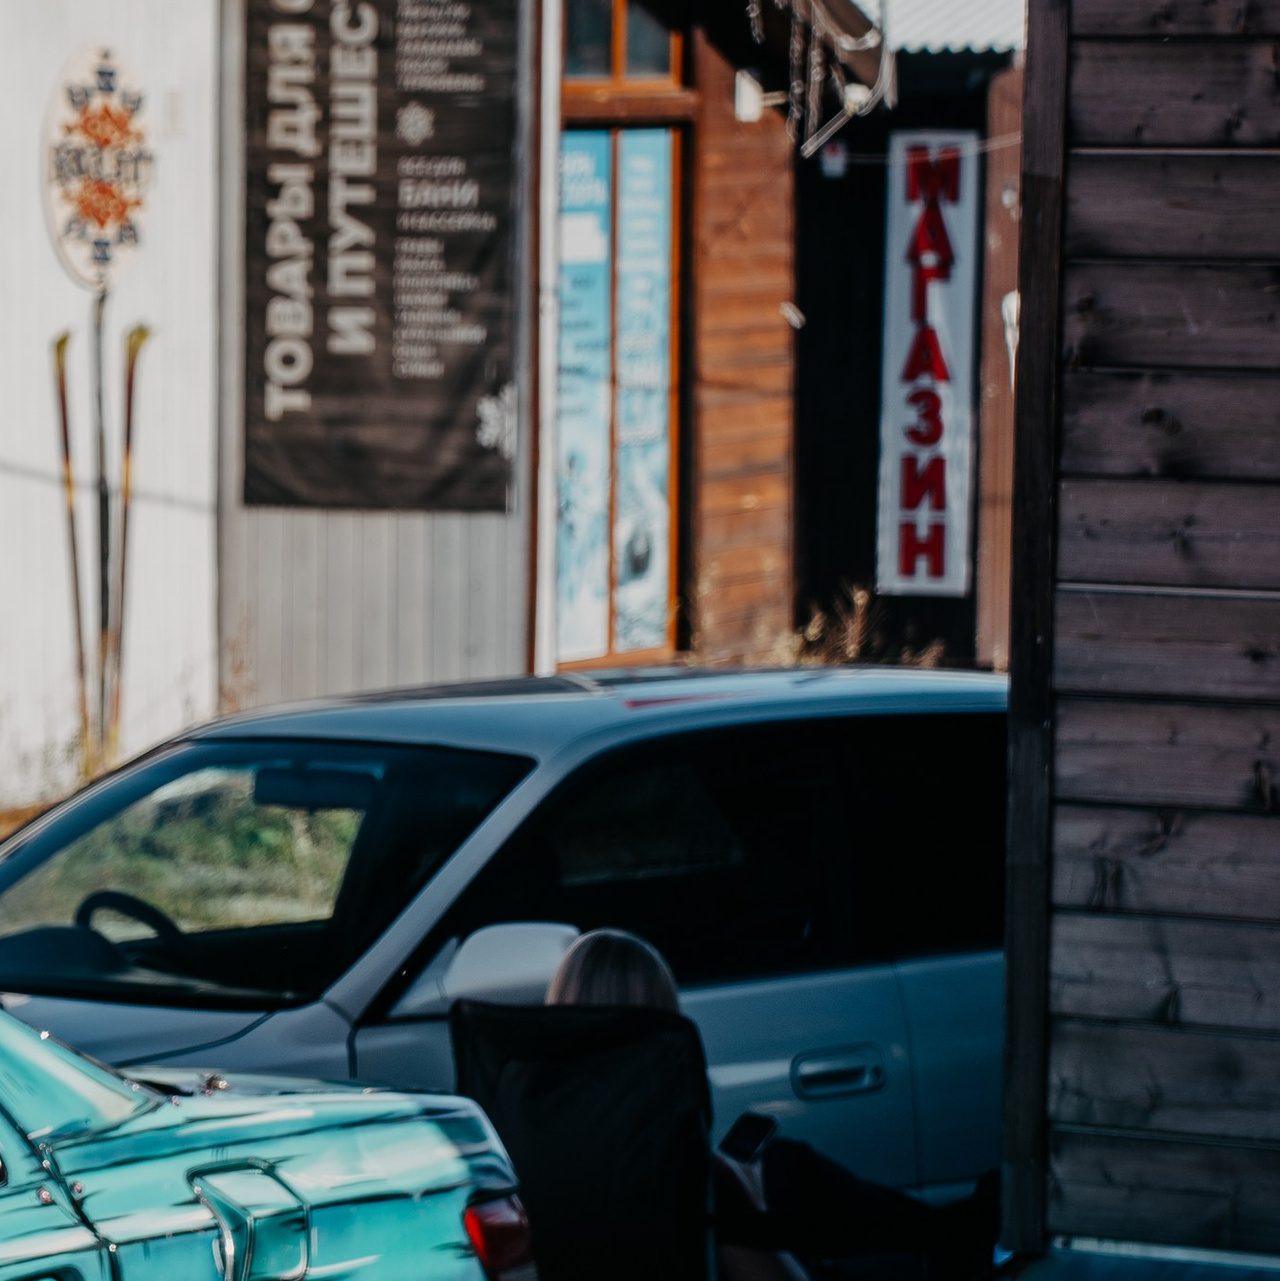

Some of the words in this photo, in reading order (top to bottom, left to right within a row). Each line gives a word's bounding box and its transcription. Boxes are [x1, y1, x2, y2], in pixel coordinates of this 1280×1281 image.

[267, 23, 322, 157] ДЛЯ
[264, 163, 316, 420] ТОВАРЫ
[326, 307, 375, 355] И
[900, 144, 961, 578] МАГАЗИН
